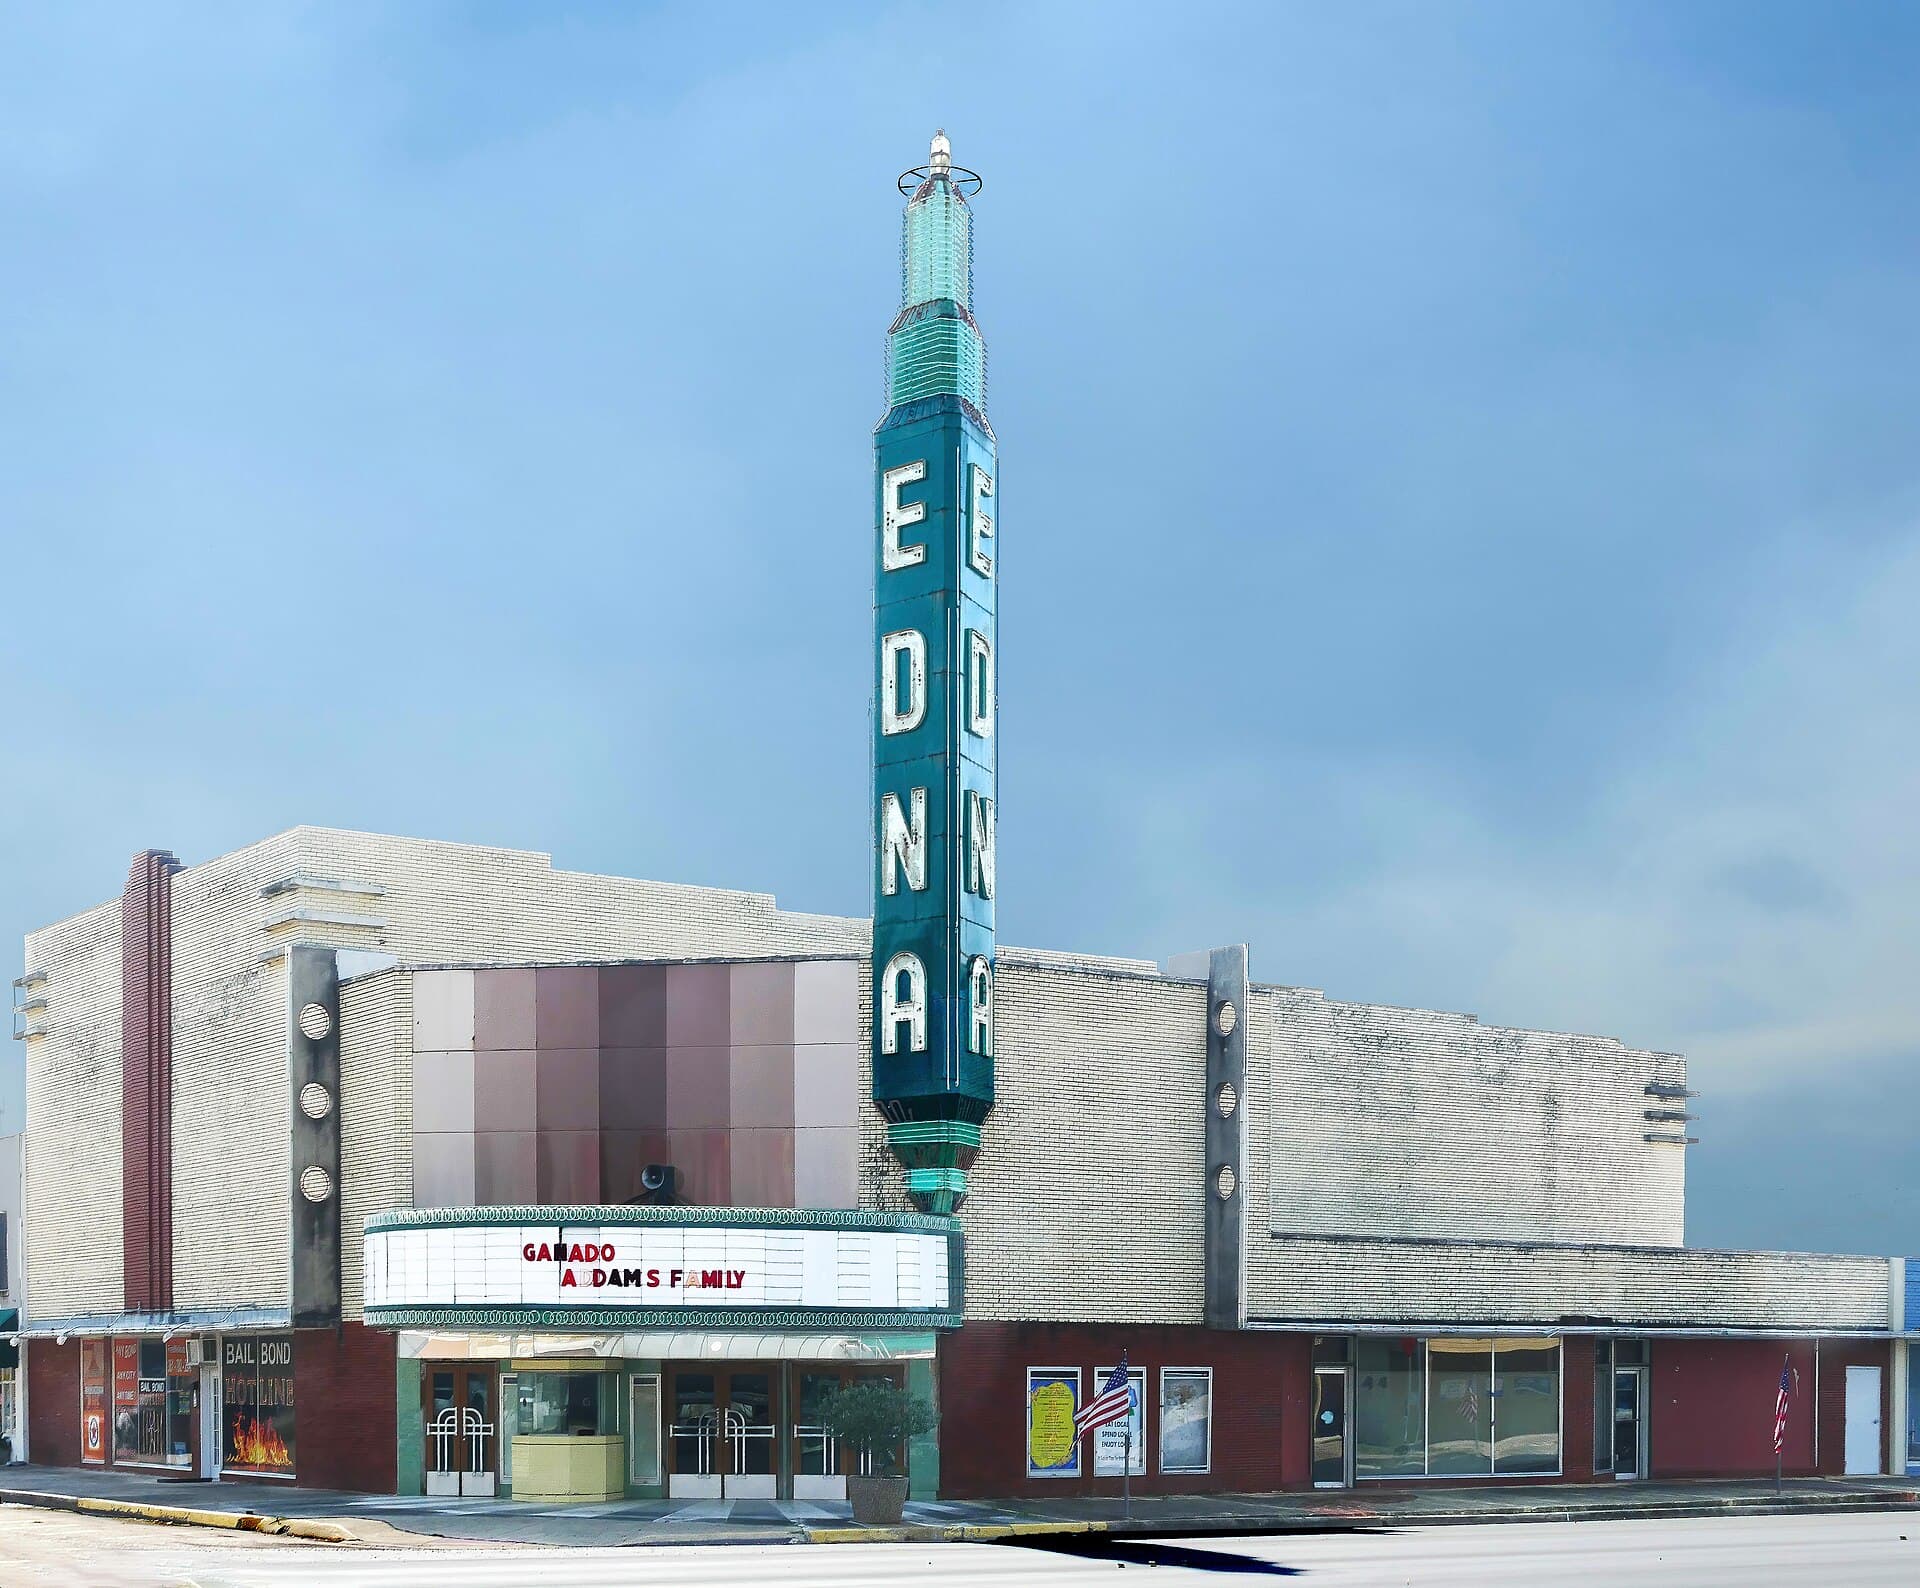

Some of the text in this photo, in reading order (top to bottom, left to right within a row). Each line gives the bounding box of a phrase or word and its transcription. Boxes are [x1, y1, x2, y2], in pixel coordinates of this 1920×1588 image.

[881, 458, 927, 1056] EDNA
[966, 462, 994, 1058] EDNA
[522, 1243, 616, 1263] GANADO
[670, 1269, 746, 1289] FAMILY
[226, 1342, 291, 1365] BAIL BOND
[140, 1382, 165, 1392] BAIL BOND
[225, 1376, 295, 1406] HOTLINE
